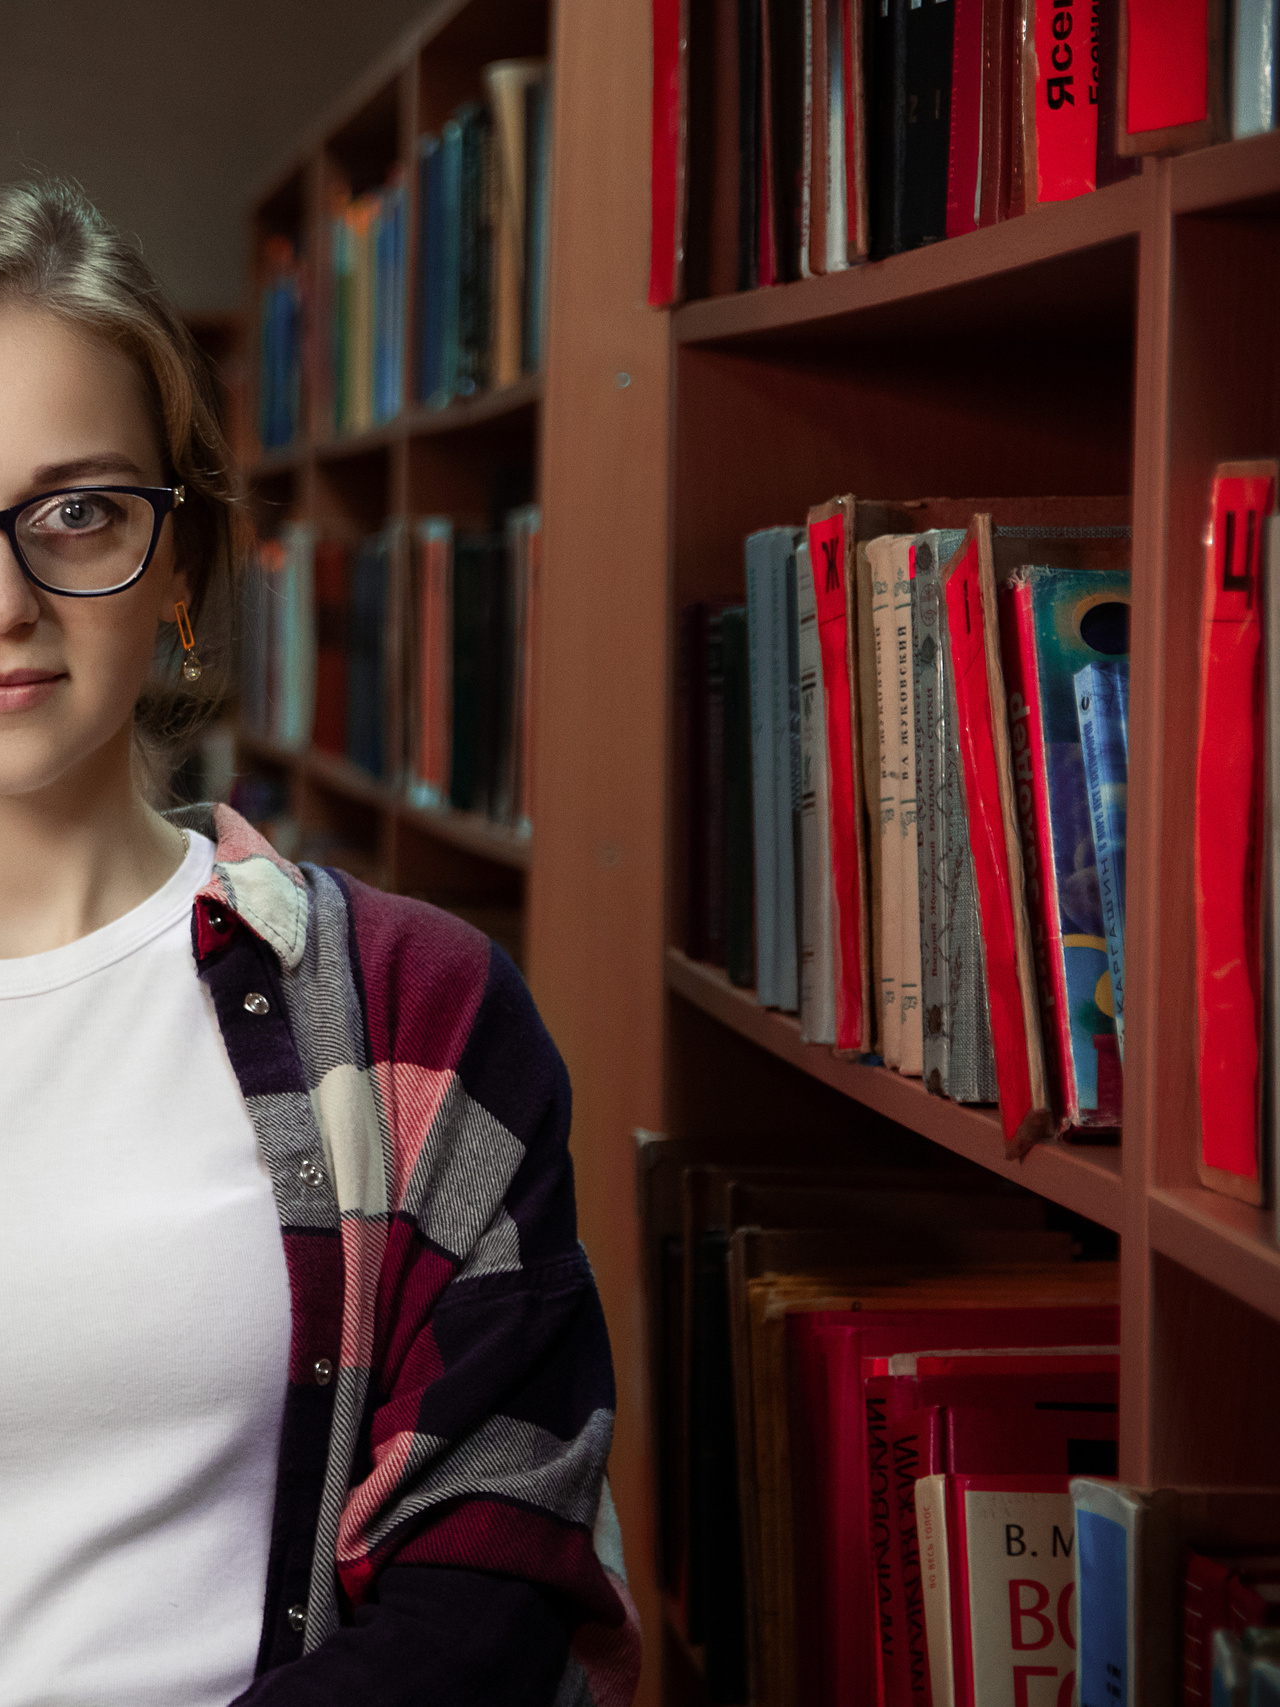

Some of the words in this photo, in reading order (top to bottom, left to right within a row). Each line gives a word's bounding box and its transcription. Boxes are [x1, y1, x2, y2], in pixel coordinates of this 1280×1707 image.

[822, 536, 840, 595] Ж
[897, 626, 909, 746] ЖУКОВСКИЙ
[926, 688, 934, 740] СТИХИ
[928, 760, 936, 832] БАЛЛАДЫ
[928, 842, 937, 915] Жуковский
[930, 924, 938, 977] Василий
[1101, 857, 1124, 1015] КАРГАШИН
[1006, 1523, 1038, 1557] В.
